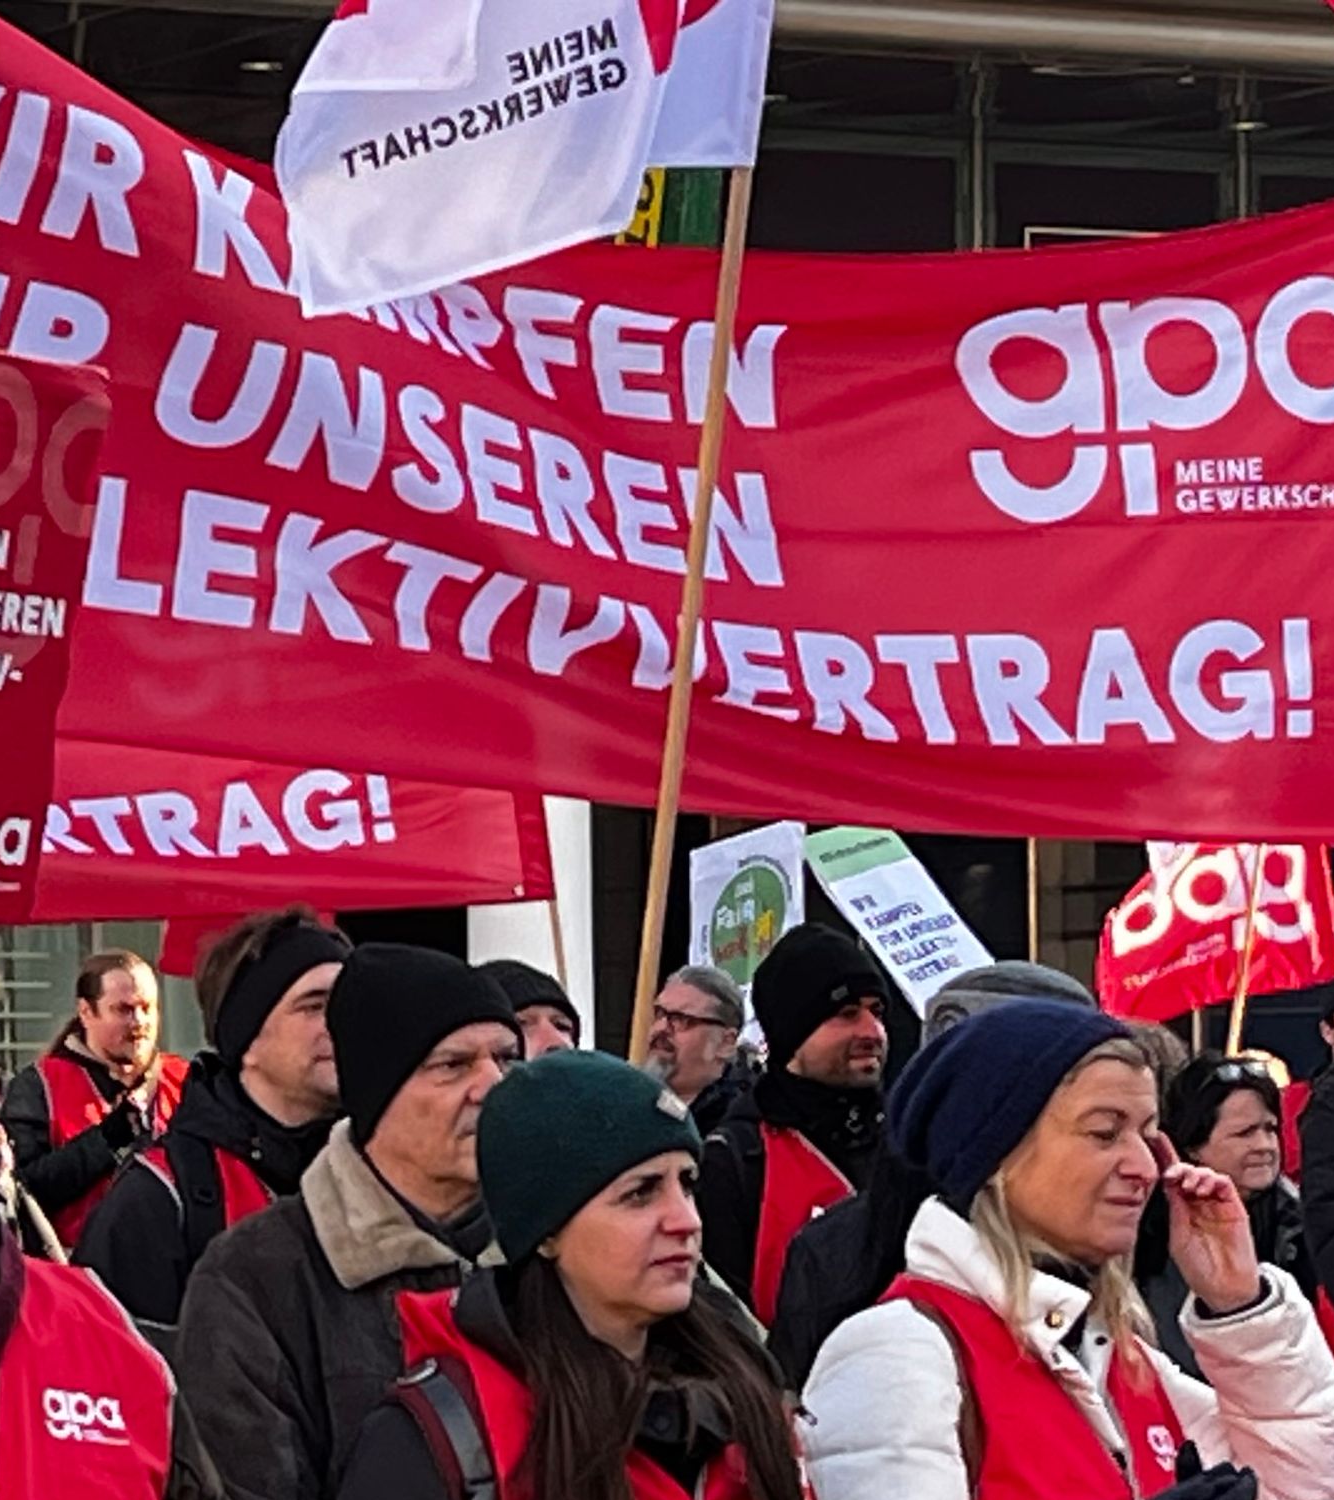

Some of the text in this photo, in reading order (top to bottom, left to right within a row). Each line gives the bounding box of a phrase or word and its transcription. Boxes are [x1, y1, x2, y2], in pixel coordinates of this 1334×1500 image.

[183, 148, 788, 428] KPFEN
[155, 323, 784, 588] UNSEREN
[1175, 457, 1263, 485] MEINE
[41, 1386, 126, 1441] gpa
